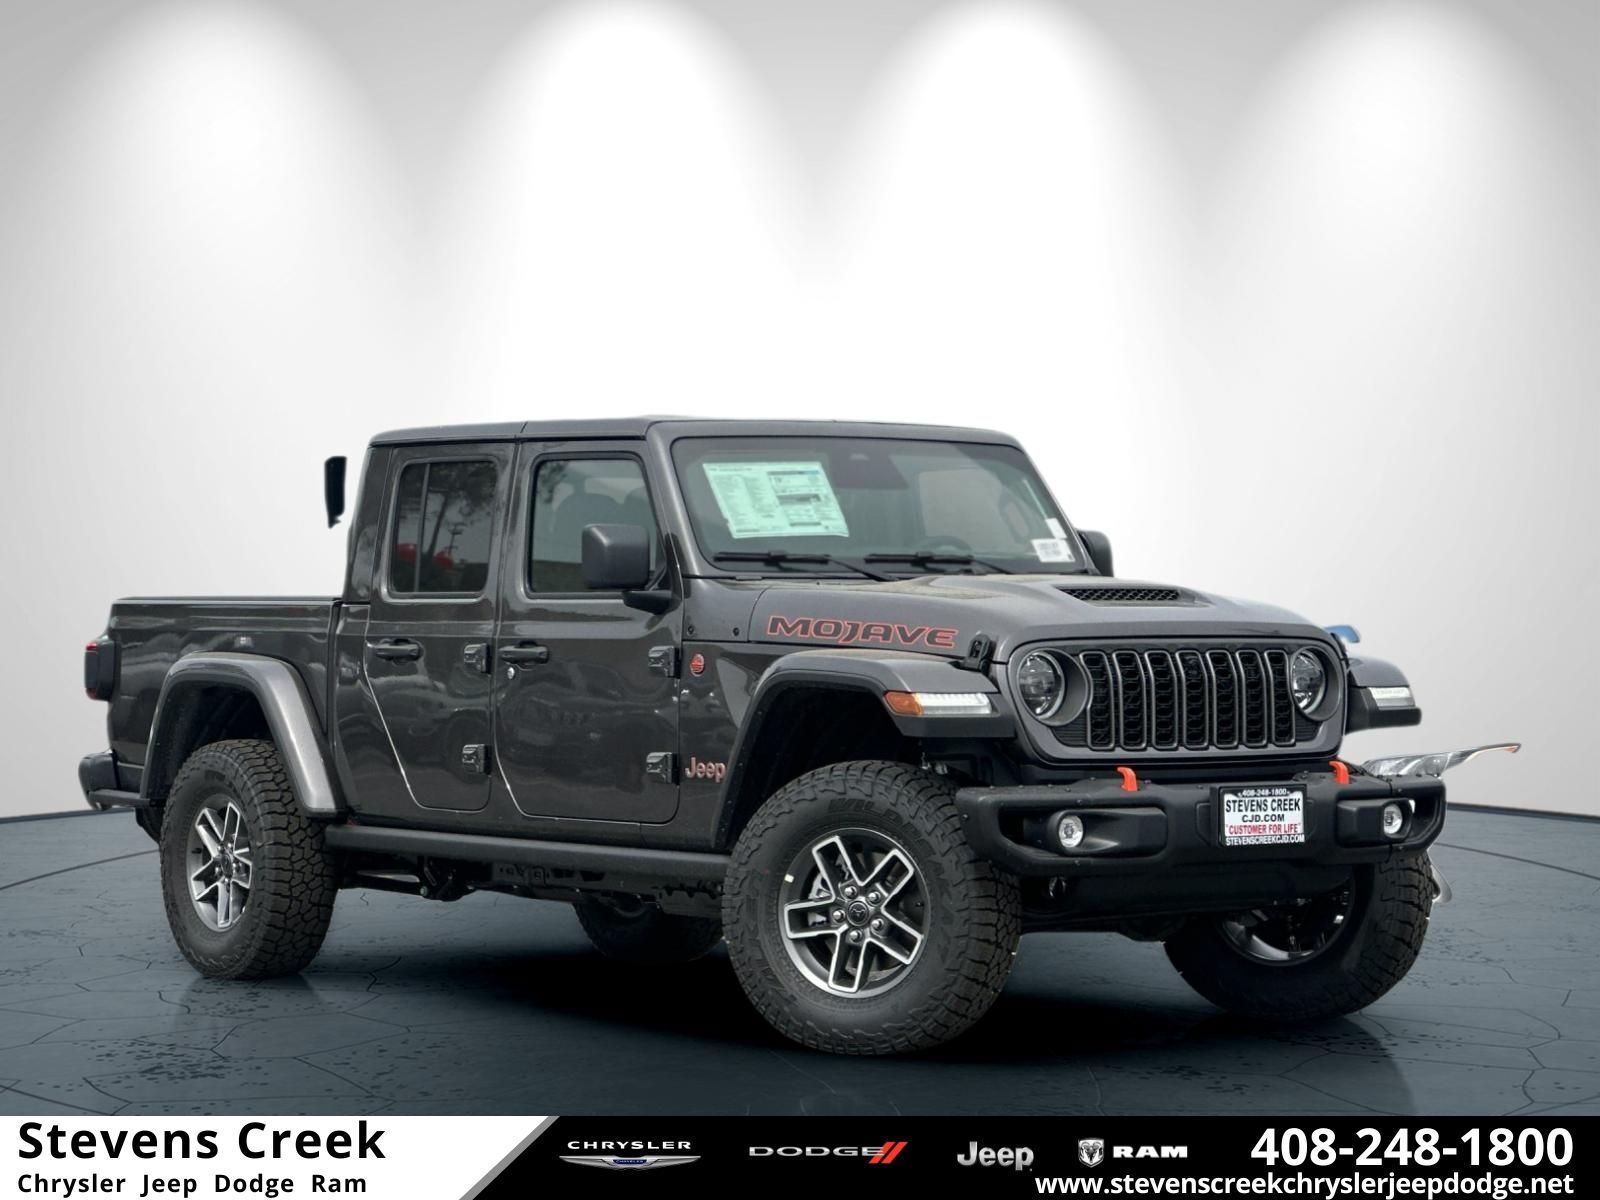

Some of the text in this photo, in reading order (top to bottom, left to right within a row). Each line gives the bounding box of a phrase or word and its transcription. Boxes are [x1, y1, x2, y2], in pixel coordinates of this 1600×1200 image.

[768, 615, 959, 648] MOJAVE
[685, 757, 725, 782] Jeep
[1226, 797, 1300, 812] STEVENS CREEK
[1241, 814, 1285, 823] CJD.COM
[1268, 824, 1282, 833] FOR
[1226, 834, 1305, 846] STEVENSCREEKCJD.COM
